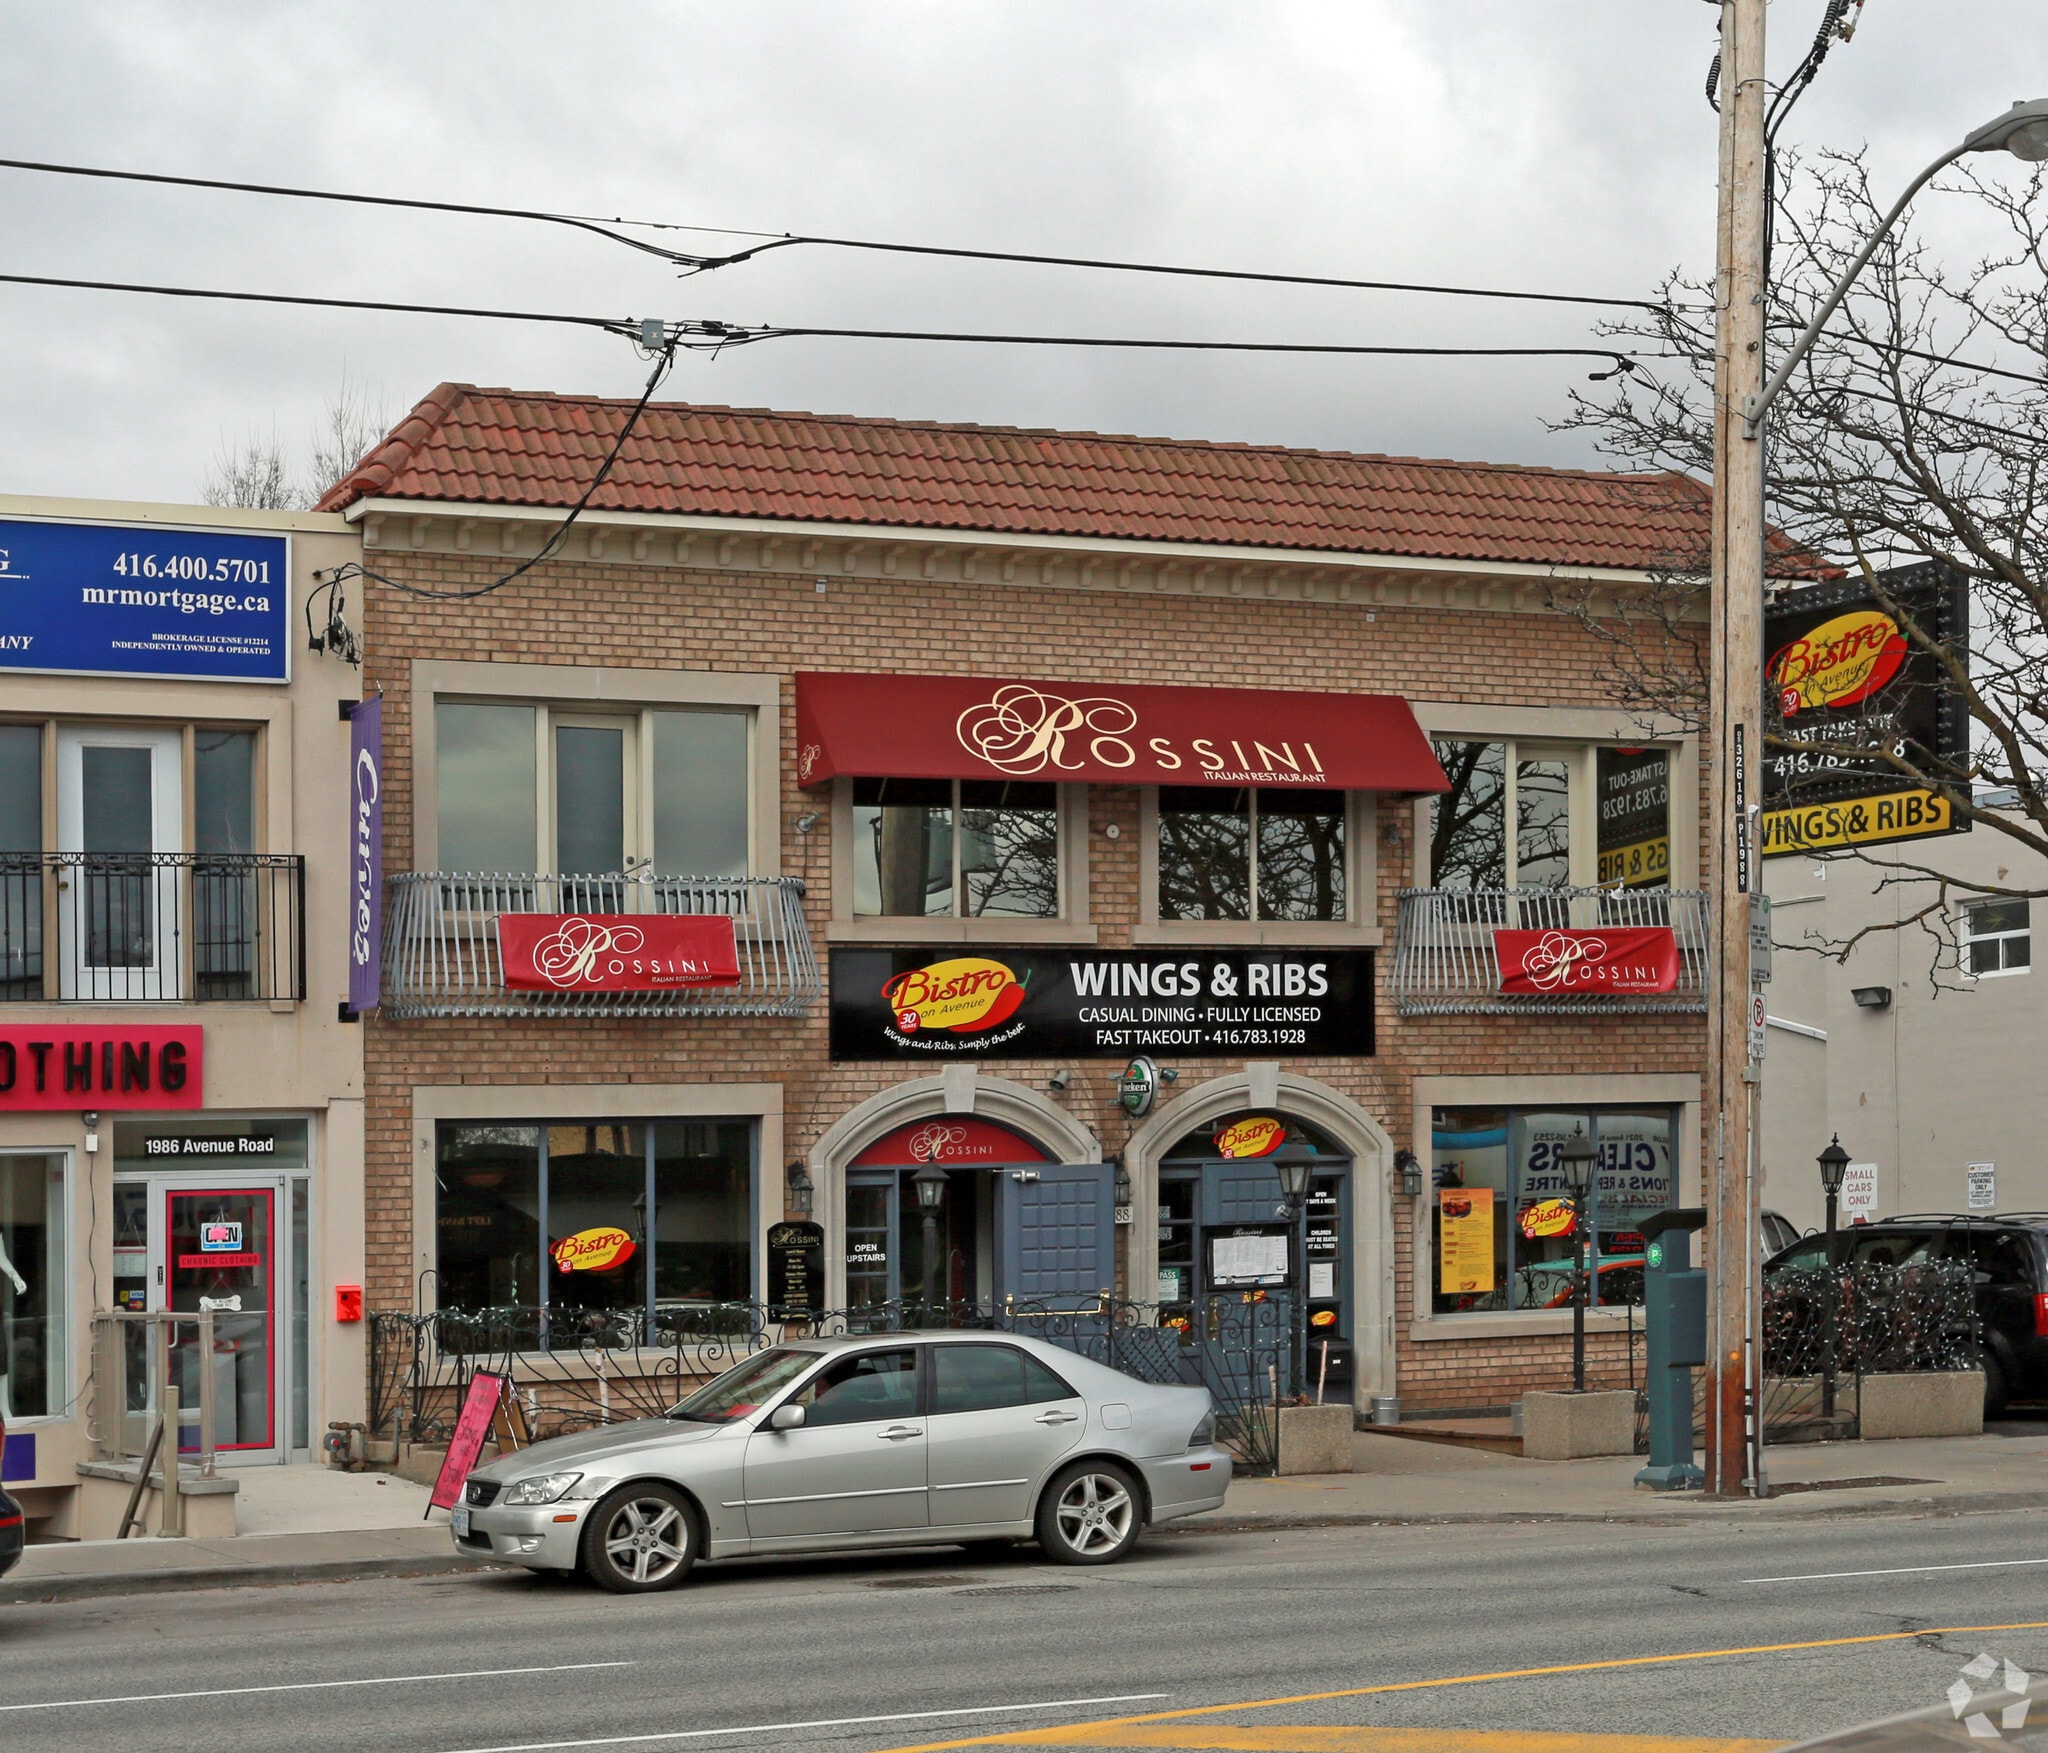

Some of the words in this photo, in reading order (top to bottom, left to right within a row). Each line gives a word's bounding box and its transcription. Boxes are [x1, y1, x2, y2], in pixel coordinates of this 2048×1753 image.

[113, 552, 271, 584] 416.400.5701
[82, 587, 270, 615] mrmortgage.ca
[112, 641, 182, 651] INDEPENDENTLY
[184, 644, 216, 653] OWNED
[226, 646, 271, 655] OPERATED
[152, 633, 206, 643] BROKERAGE
[207, 635, 242, 645] LICENSE
[244, 637, 269, 645] #12214
[1765, 622, 1888, 688] Bistro
[956, 684, 1323, 775] ROSSINI
[1203, 770, 1250, 782] ITALIAN
[1252, 771, 1326, 784] RESTAURANT
[1850, 804, 1869, 835] &
[1878, 795, 1942, 831] RIBS
[533, 917, 709, 987] ROSSINI
[1522, 931, 1657, 990] ROSSINI
[881, 969, 1006, 1010] Bistro
[1070, 963, 1201, 997] WINGS
[1210, 963, 1239, 997] &
[1248, 963, 1329, 997] RIBS
[921, 1009, 936, 1019] on
[940, 998, 985, 1014] Avenue
[1078, 1007, 1138, 1023] CASUAL
[1142, 1007, 1195, 1022] DINING
[1207, 1007, 1250, 1022] FULLY
[1253, 1006, 1321, 1022] LICENSED
[900, 1012, 917, 1025] 30
[883, 1026, 911, 1046] Wings
[911, 1040, 934, 1050] and
[958, 1037, 990, 1050] Simply
[991, 1034, 1008, 1045] the
[1096, 1030, 1131, 1044] FAST
[1133, 1030, 1202, 1044] TAKEOUT
[1212, 1029, 1306, 1044] 416.783.1928
[909, 1123, 992, 1162] ROSSINI
[1212, 1122, 1276, 1149] Bistro
[145, 1139, 180, 1154] 1986
[183, 1139, 235, 1153] Avenue
[239, 1138, 274, 1153] Road
[1845, 1169, 1875, 1180] SMALL
[1847, 1182, 1872, 1193] CARS
[1848, 1195, 1871, 1205] ONLY
[548, 1233, 624, 1260] Bistro
[855, 1243, 877, 1252] OPEN
[181, 1256, 216, 1266] CHRONIC
[219, 1255, 258, 1265] CLOTHING
[847, 1253, 886, 1262] UPSTAIRS
[1159, 1271, 1176, 1279] PASS
